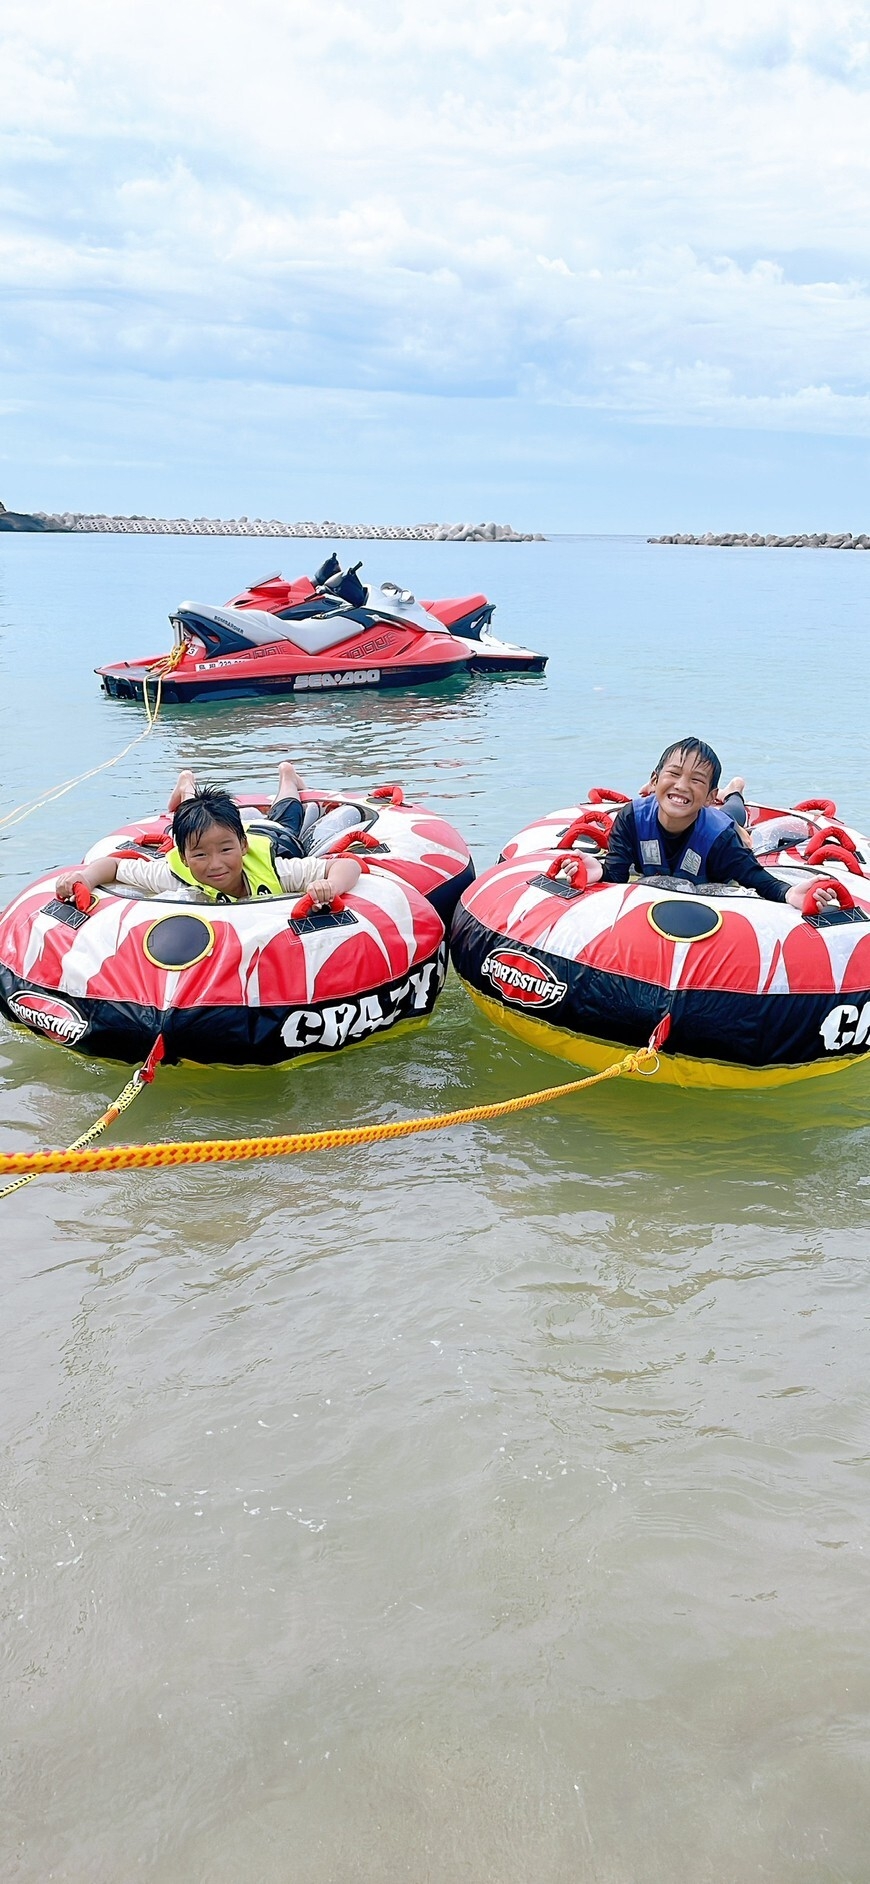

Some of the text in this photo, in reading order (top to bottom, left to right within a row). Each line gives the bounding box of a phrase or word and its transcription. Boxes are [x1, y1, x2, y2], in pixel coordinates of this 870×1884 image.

[213, 615, 244, 635] BOMBARDIER
[481, 957, 565, 1000] SPORTSSTUFF
[9, 999, 87, 1039] SPORTSSTUFF
[279, 963, 437, 1048] CRAZY
